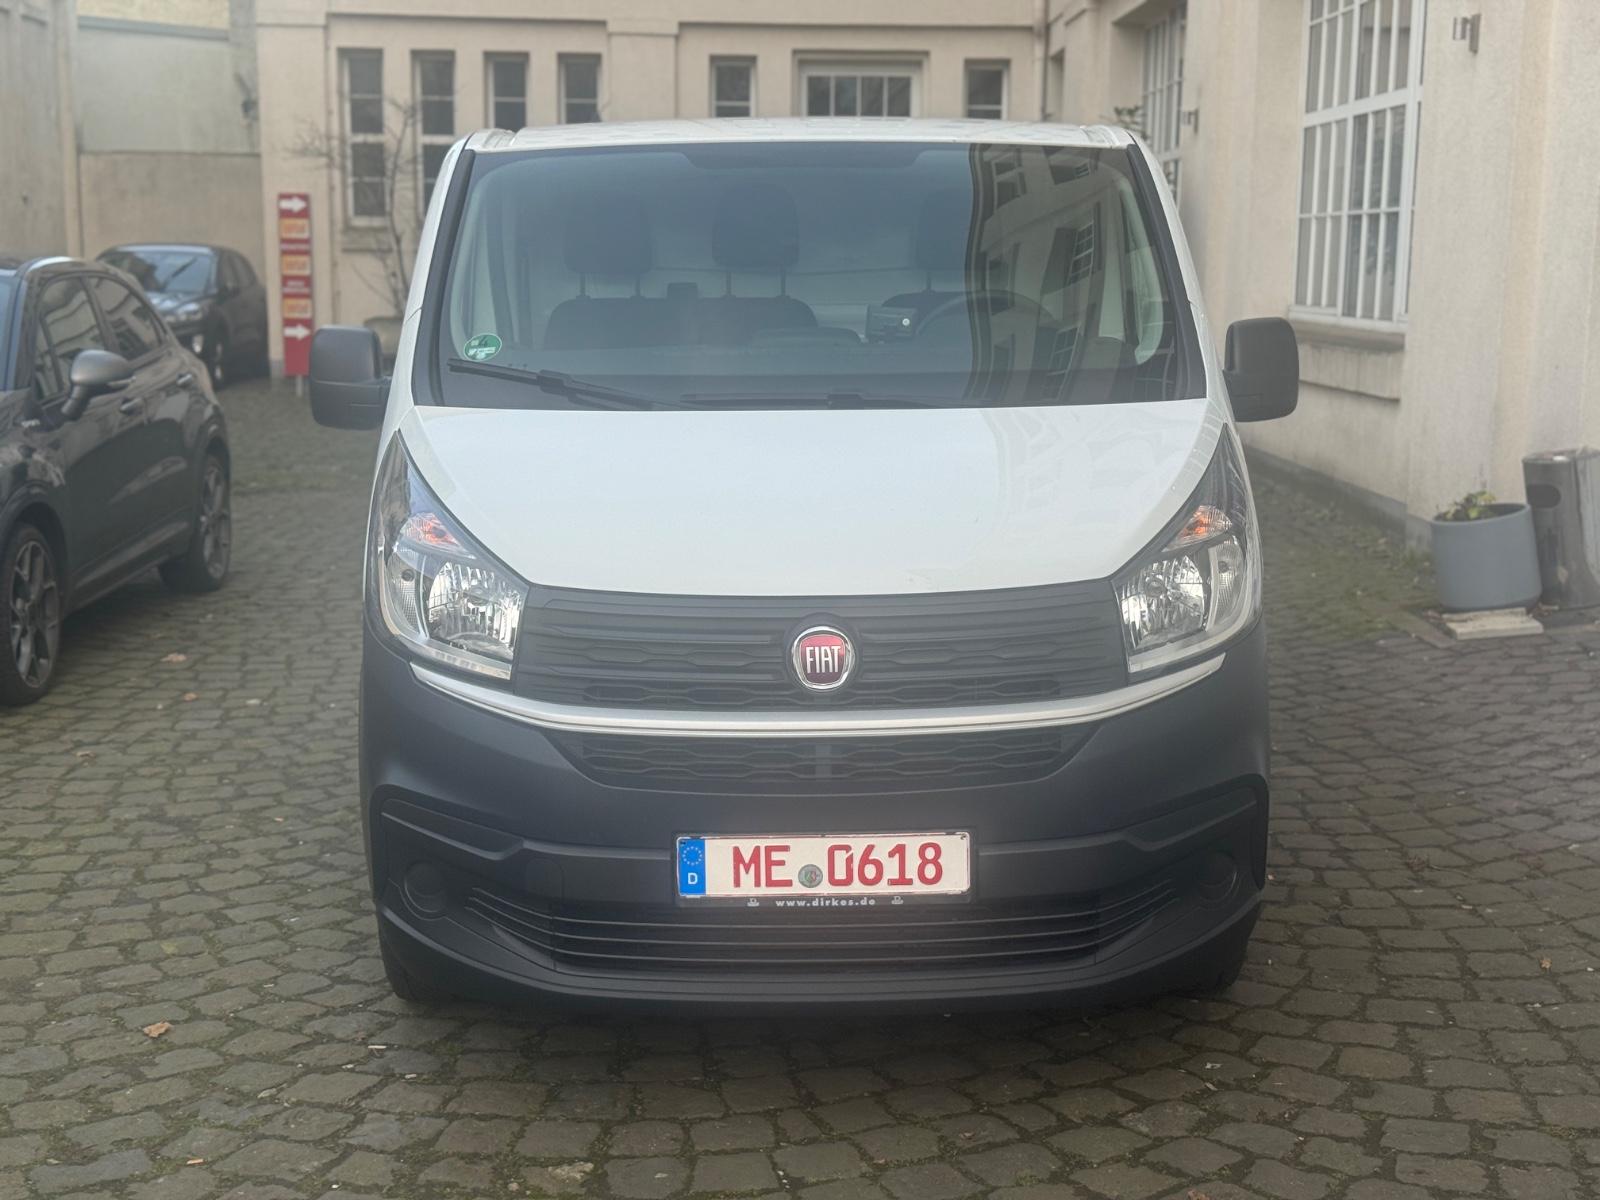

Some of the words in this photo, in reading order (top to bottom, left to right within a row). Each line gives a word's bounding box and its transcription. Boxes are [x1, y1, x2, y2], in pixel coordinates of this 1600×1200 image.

[805, 645, 842, 674] FIAT
[687, 872, 698, 885] D
[732, 845, 793, 888] ME
[827, 842, 943, 887] 0618
